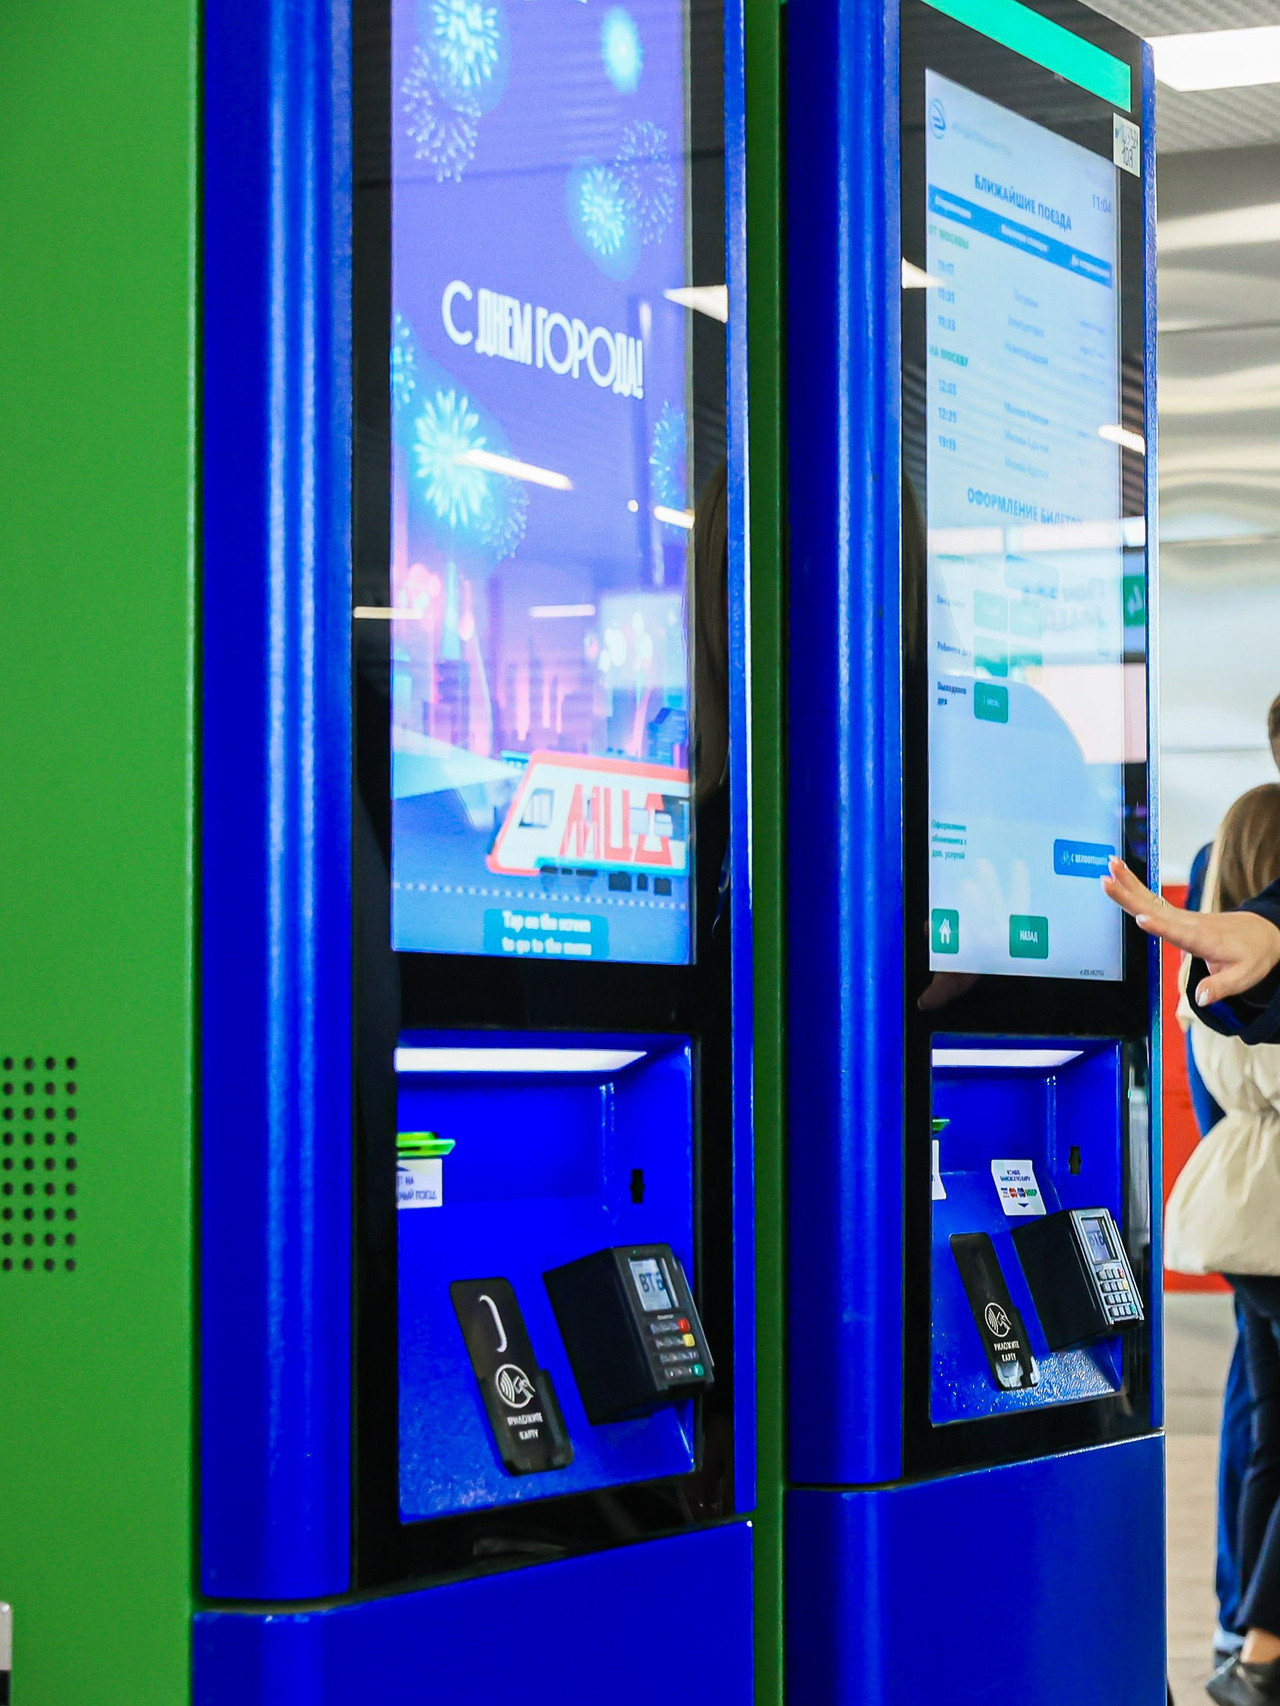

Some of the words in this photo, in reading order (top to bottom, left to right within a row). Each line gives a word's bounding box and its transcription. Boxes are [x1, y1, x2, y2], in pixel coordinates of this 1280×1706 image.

[974, 174, 1036, 214] БЛИЖАЙШИЕ
[1037, 201, 1072, 231] ПОЕЗДА
[1092, 193, 1112, 214] 11:04
[441, 279, 474, 346] С
[475, 287, 533, 366] ДНЕМ
[534, 306, 644, 400] ГОРОДА!
[967, 487, 1038, 522] ОФОРМЛЕНИЕ
[1020, 930, 1038, 944] НАЗАД
